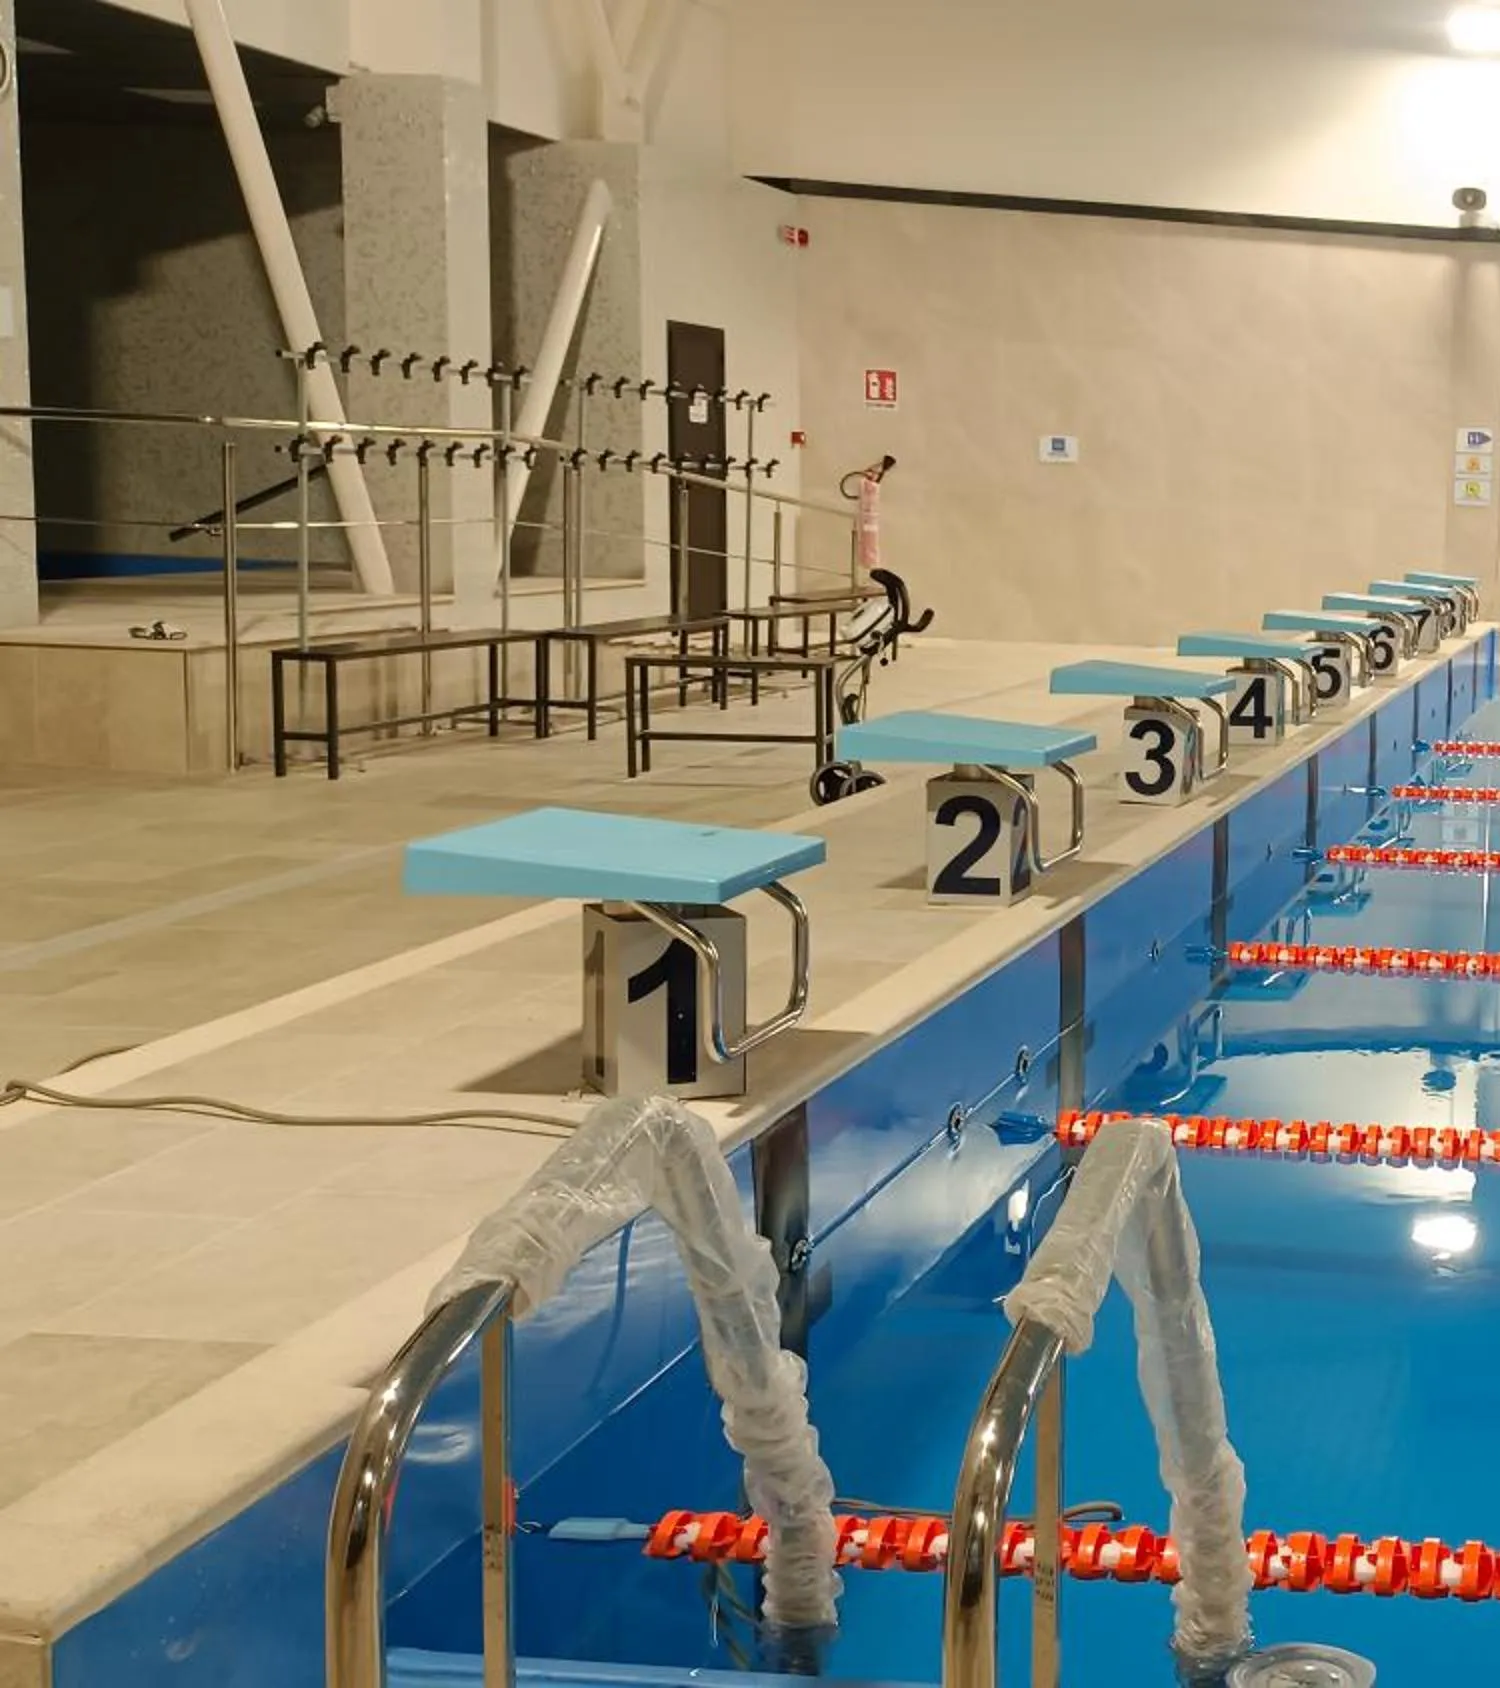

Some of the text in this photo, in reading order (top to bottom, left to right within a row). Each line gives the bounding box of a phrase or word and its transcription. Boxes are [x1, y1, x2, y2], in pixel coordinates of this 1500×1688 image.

[1368, 626, 1395, 669] 6
[1402, 609, 1431, 640] 7
[1312, 648, 1341, 699] 5
[1229, 678, 1273, 739] 4
[1125, 719, 1176, 796] 3
[932, 795, 1000, 896] 2
[628, 937, 697, 1084] 1
